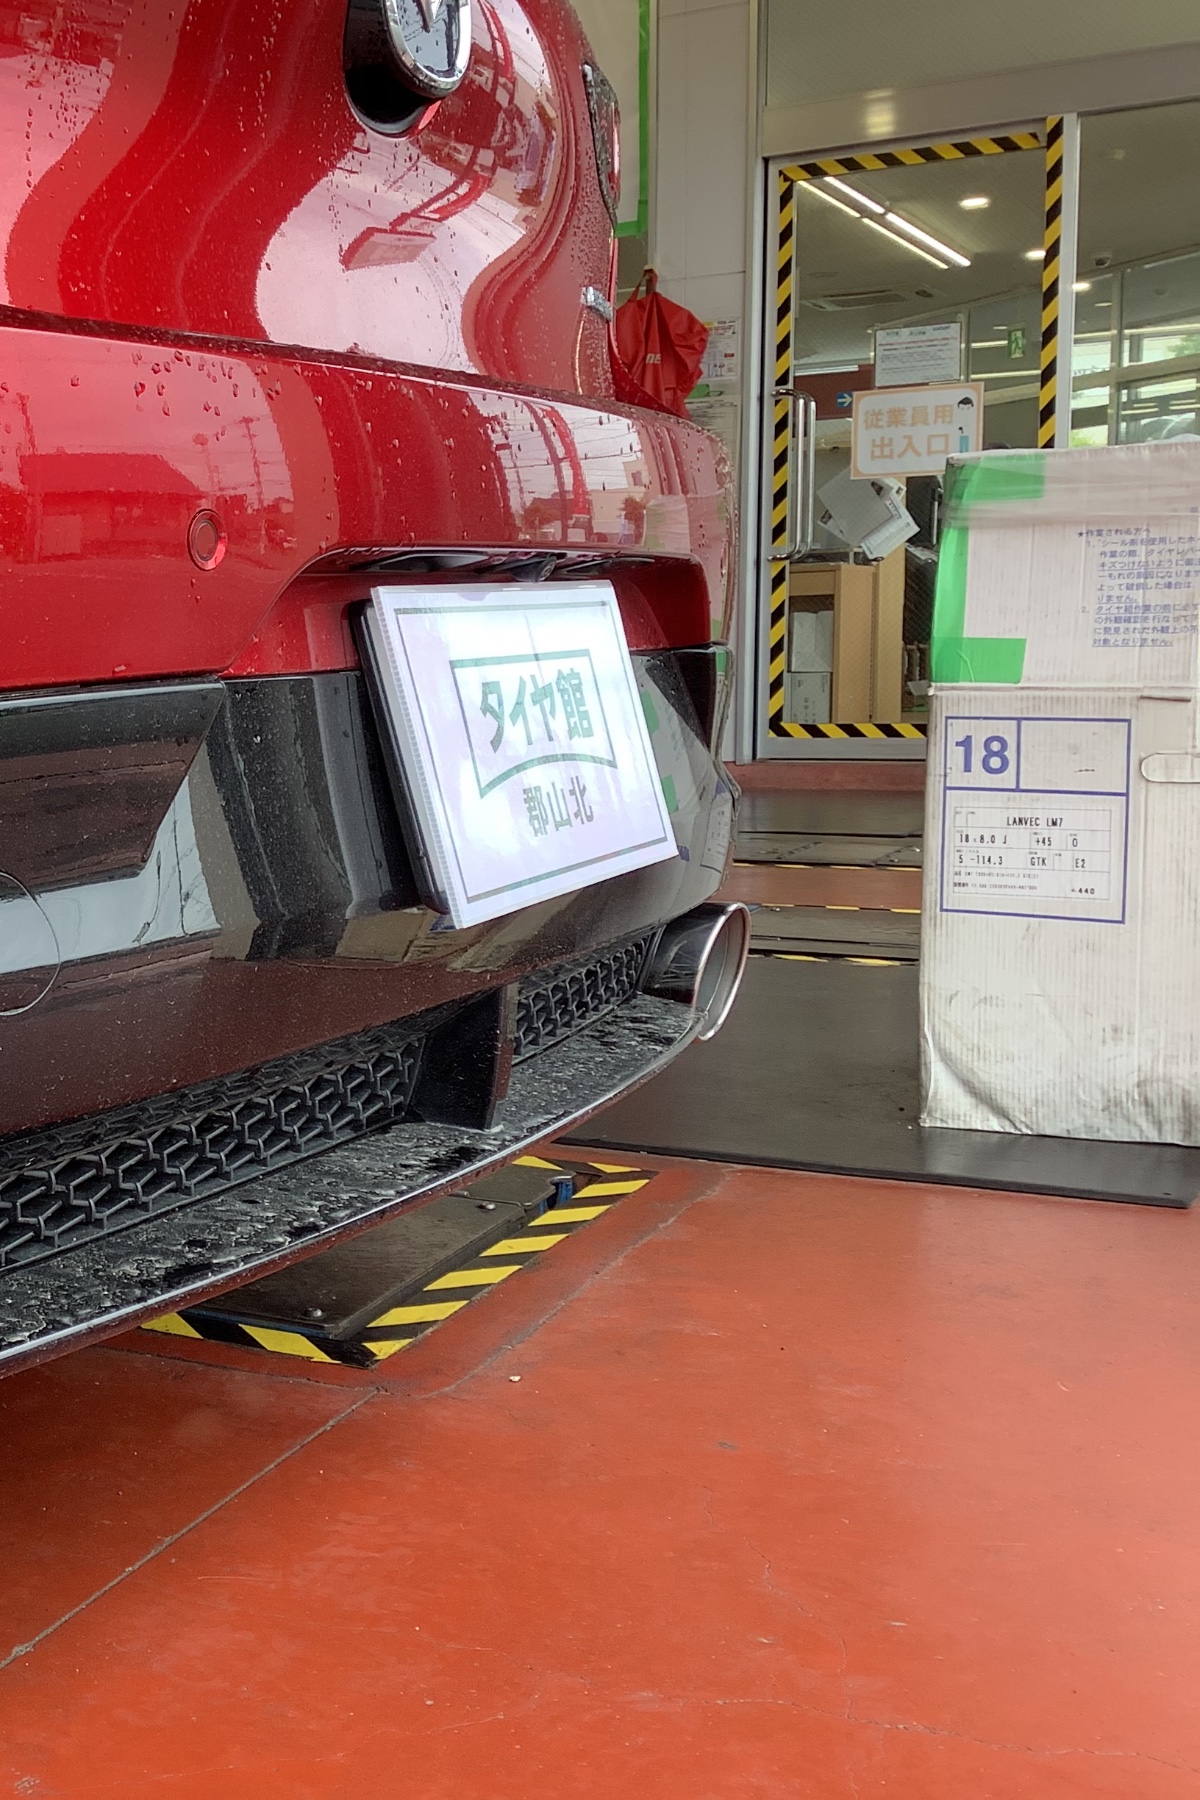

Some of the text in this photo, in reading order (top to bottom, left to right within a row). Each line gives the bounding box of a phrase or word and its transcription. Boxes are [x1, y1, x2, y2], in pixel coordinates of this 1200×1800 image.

[864, 404, 954, 430] 従業員用
[870, 433, 950, 461] 出入口
[480, 668, 594, 753] タイヤ館
[955, 735, 1009, 775] 18
[522, 775, 595, 837] 郡山北
[1006, 816, 1063, 827] LANVEC LM7
[959, 833, 970, 843] 18
[979, 834, 996, 844] 8.0
[1035, 837, 1052, 847] +45
[958, 854, 964, 864] 5
[1030, 856, 1047, 867] GTK
[1074, 859, 1086, 869] E2
